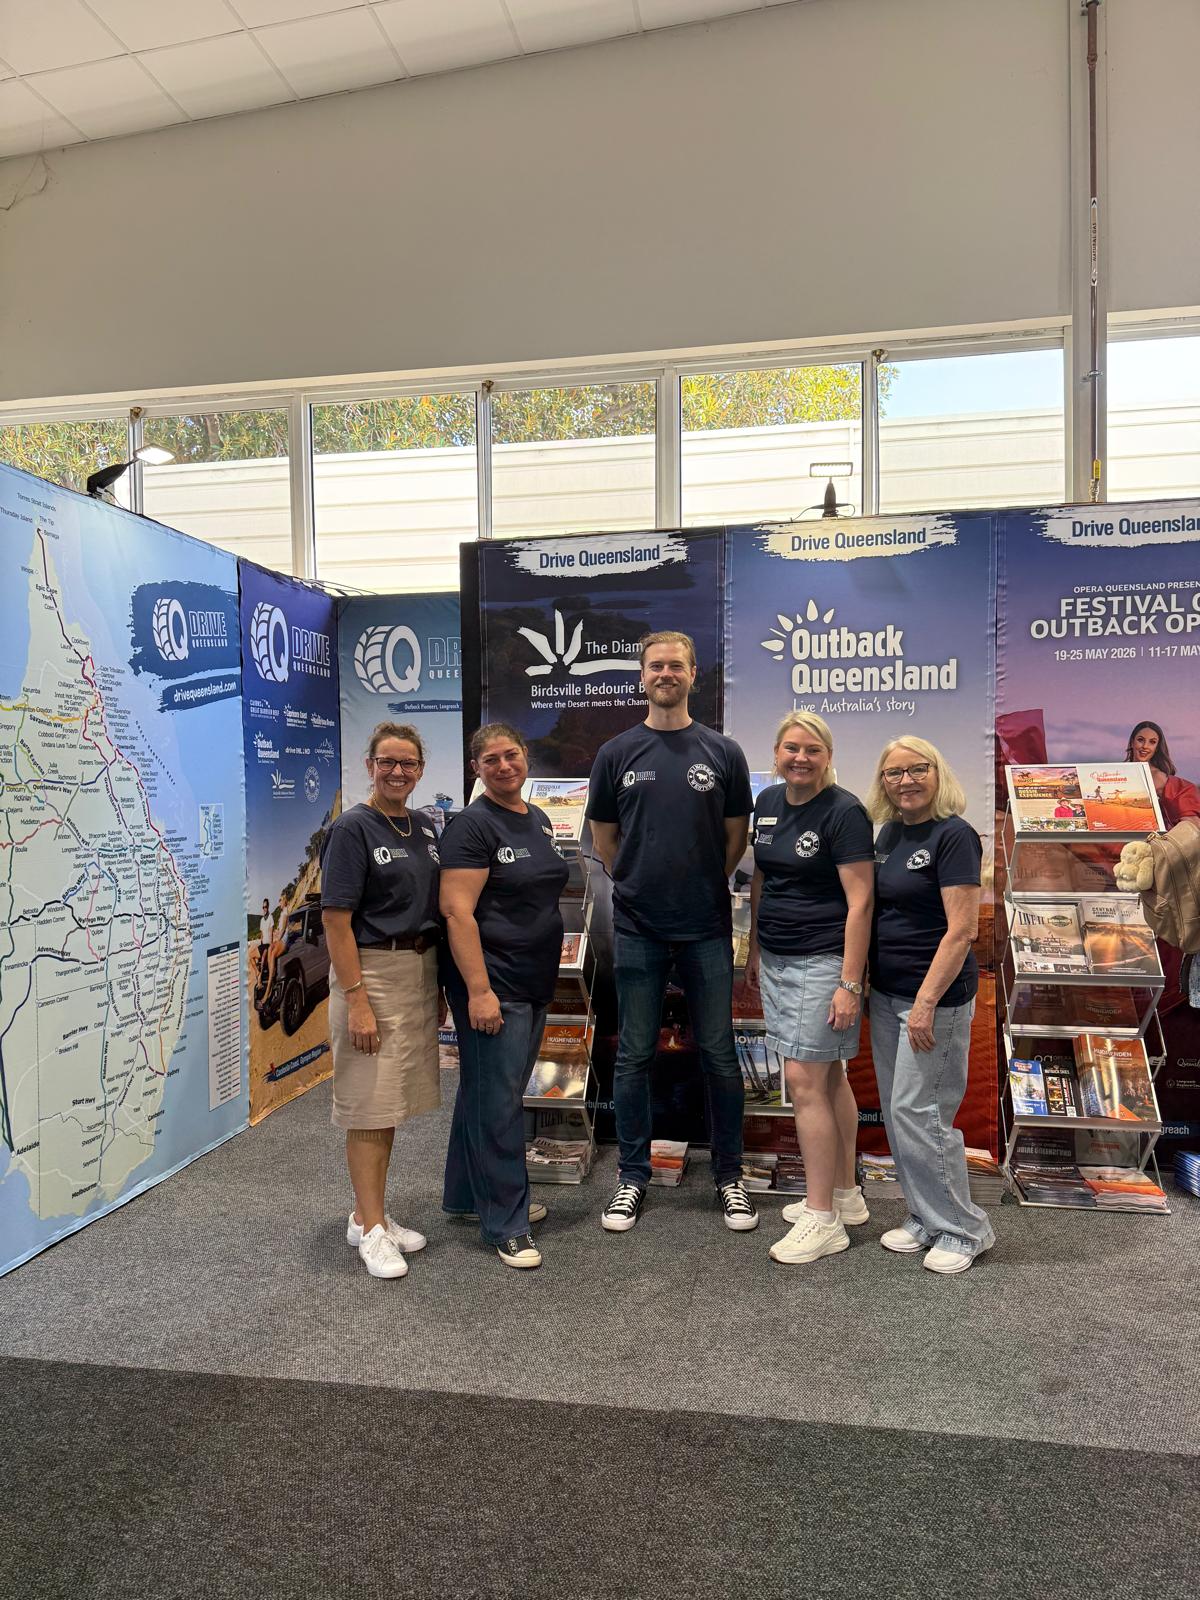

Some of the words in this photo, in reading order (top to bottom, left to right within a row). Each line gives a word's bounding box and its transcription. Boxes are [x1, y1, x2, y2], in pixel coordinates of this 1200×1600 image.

[1072, 520, 1114, 538] Drive
[791, 535, 830, 551] Drive
[834, 528, 926, 549] Queensland
[539, 552, 575, 568] Drive
[578, 544, 660, 567] Queensland
[1074, 586, 1103, 594] OPERA
[1105, 582, 1166, 593] QUEENSLAND
[1060, 594, 1185, 618] FESTIVAL
[188, 611, 228, 637] DRIVE
[1030, 615, 1158, 639] OUTBACK
[291, 626, 330, 666] DRIVE
[585, 640, 608, 654] The
[791, 624, 904, 661] Outback
[1054, 650, 1083, 661] 19-25
[1086, 649, 1110, 660] MAY
[1110, 647, 1136, 658] 2026
[1148, 646, 1178, 658] 11-17
[292, 660, 330, 678] QUEENSLAND
[791, 658, 958, 694] Queensland
[531, 684, 582, 697] Birdsville
[584, 682, 636, 695] Bedourie
[530, 701, 553, 709] Where
[554, 700, 566, 708] the
[567, 700, 590, 708] Desert
[591, 699, 612, 707] meets
[793, 698, 816, 713] Live
[820, 697, 882, 714] Australia's
[886, 696, 916, 716] story
[257, 738, 273, 749] Outback
[257, 749, 280, 759] Queensland
[62, 1029, 78, 1040] Barrier
[72, 1098, 84, 1107] Sturt
[16, 1141, 40, 1156] Adelaide
[71, 1182, 98, 1199] Melbourne
